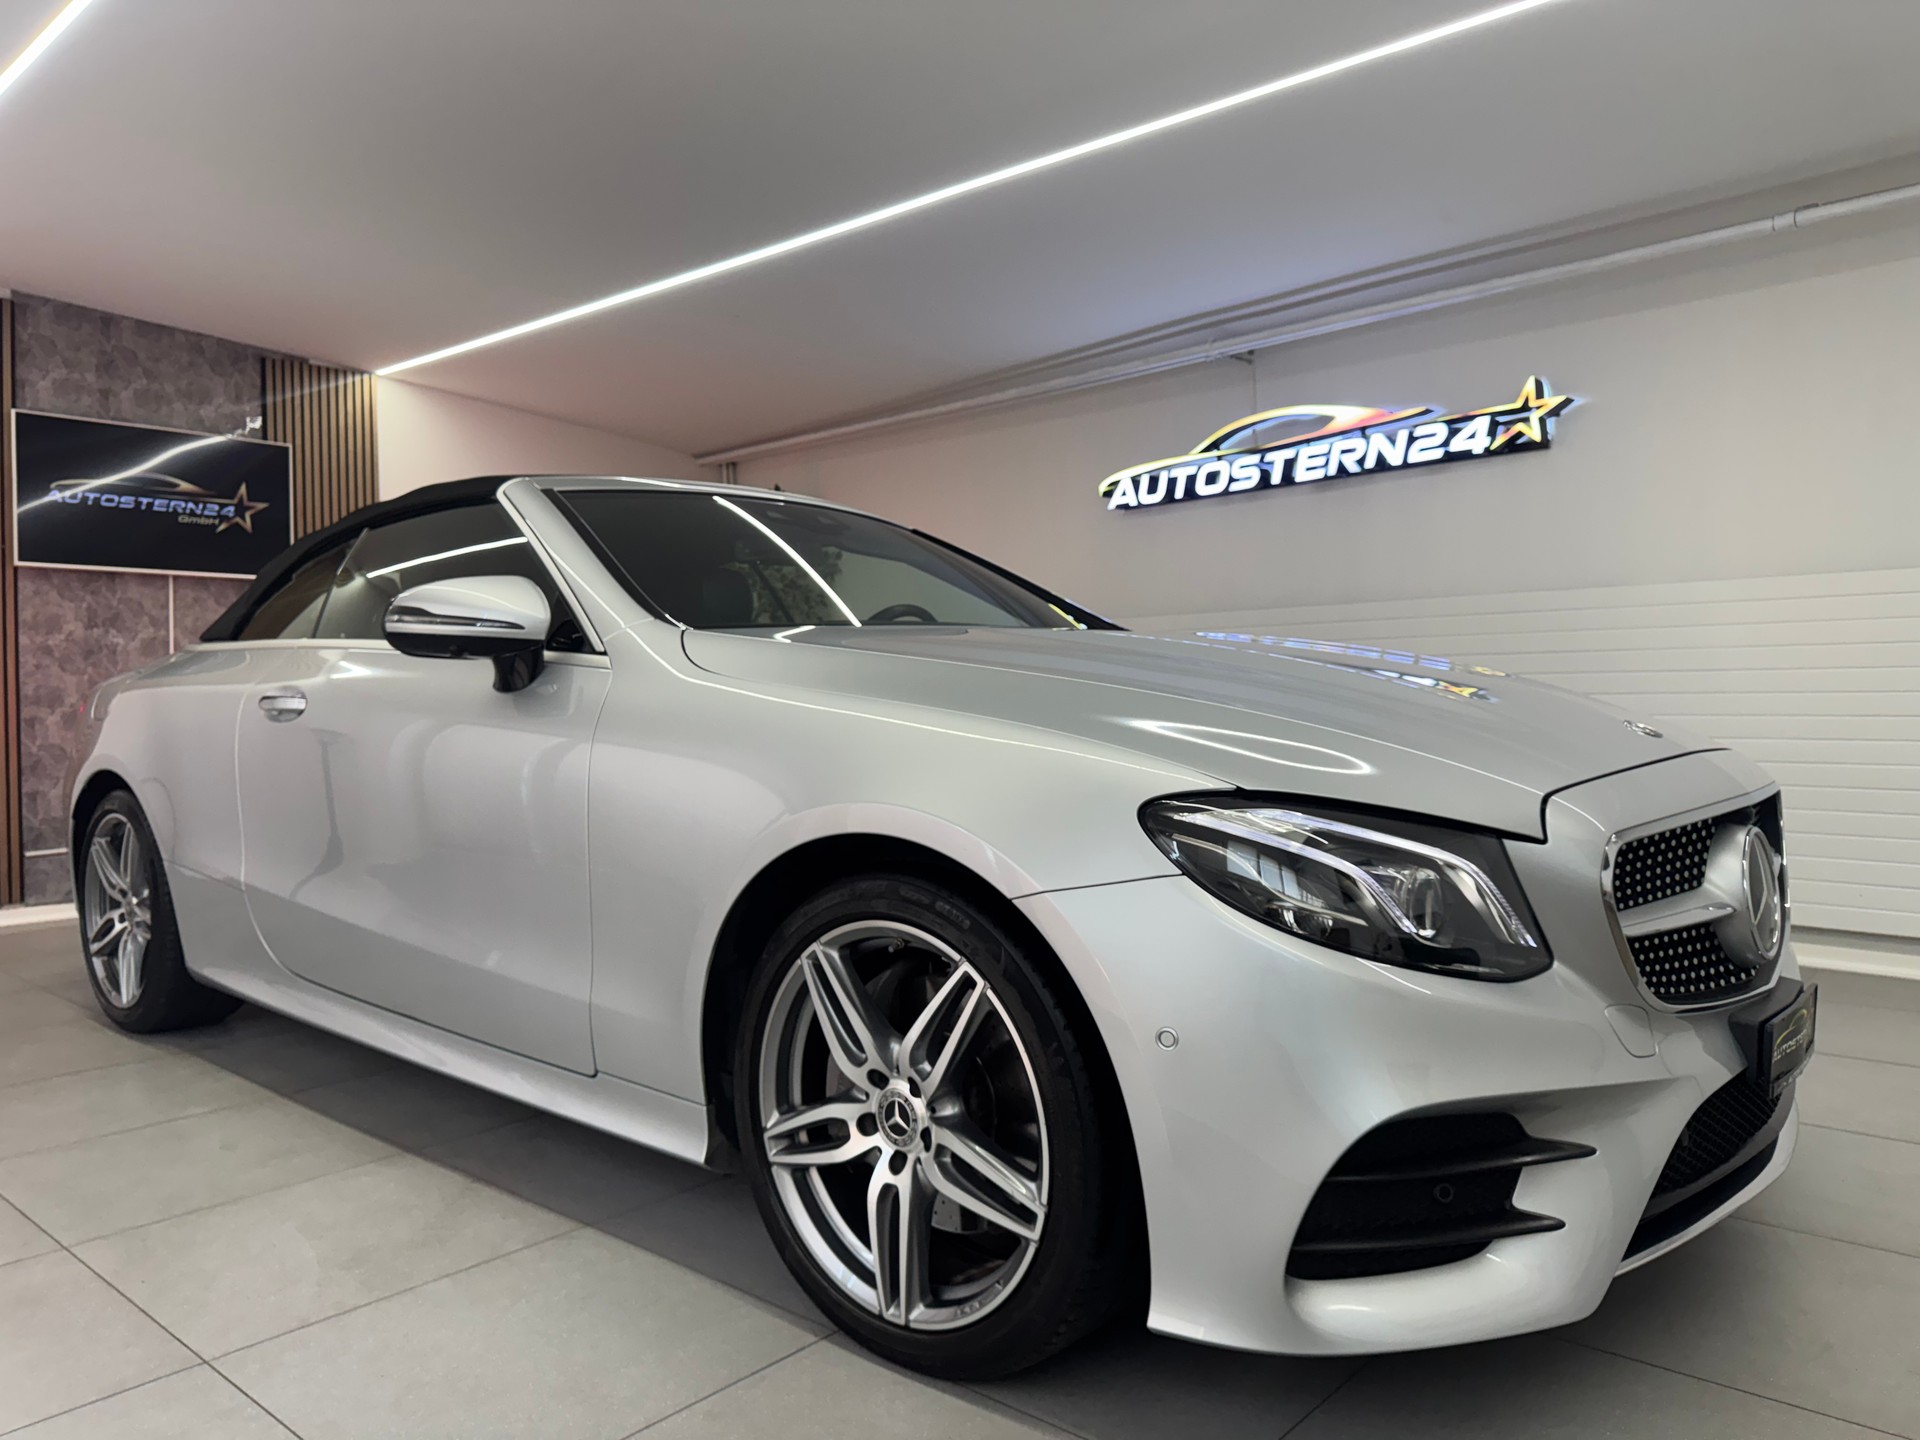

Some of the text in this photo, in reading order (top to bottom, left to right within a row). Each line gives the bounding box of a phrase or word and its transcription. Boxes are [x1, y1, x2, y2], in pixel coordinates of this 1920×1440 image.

[1107, 414, 1492, 510] AUTOSTERN24
[48, 489, 236, 517] AUTOSTERN24
[178, 514, 219, 526] GmbH
